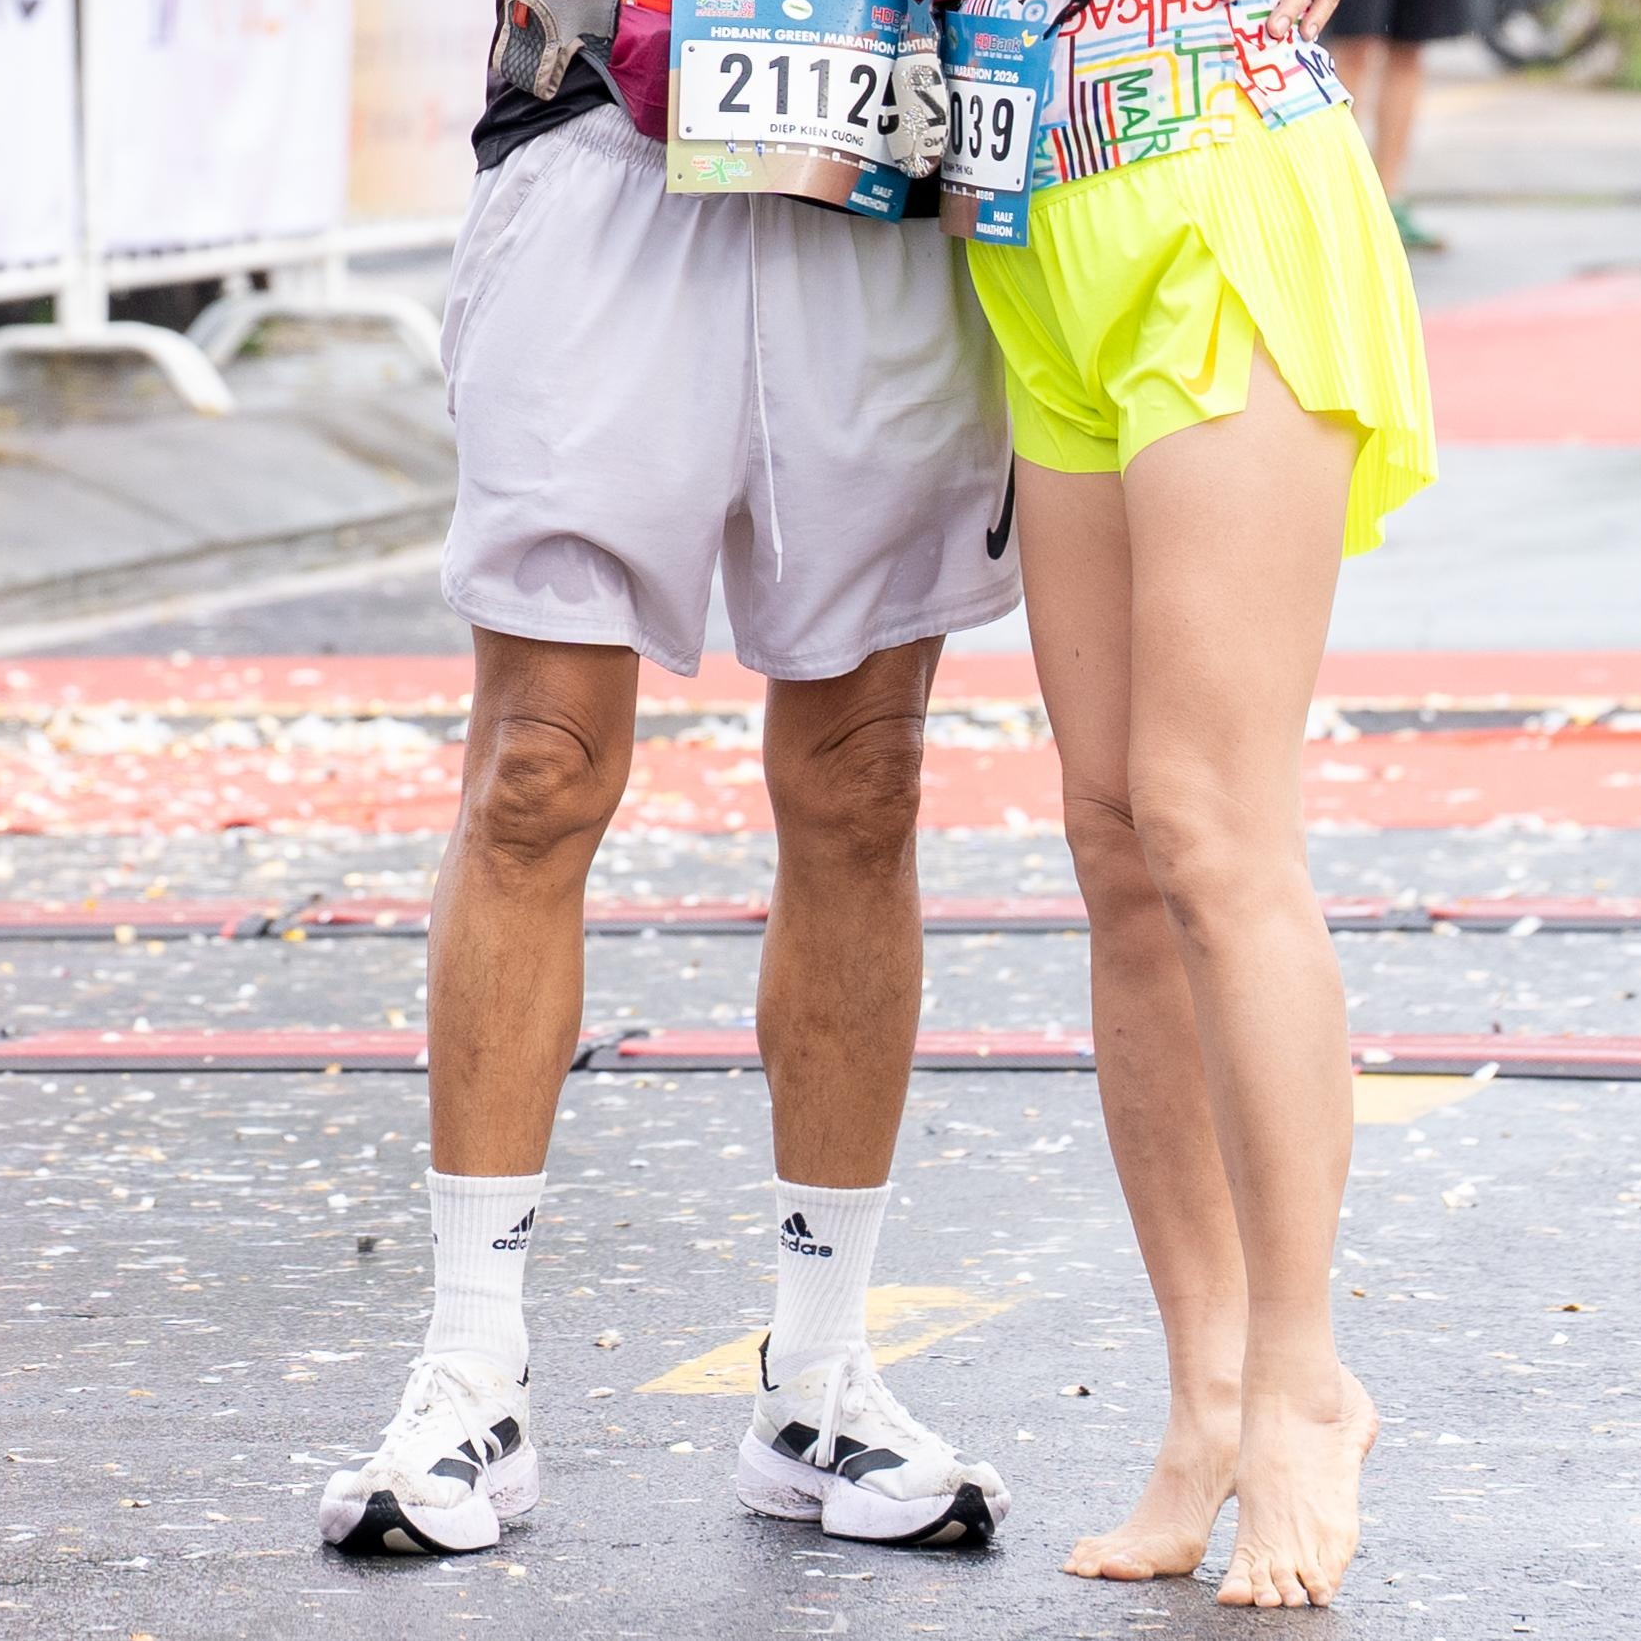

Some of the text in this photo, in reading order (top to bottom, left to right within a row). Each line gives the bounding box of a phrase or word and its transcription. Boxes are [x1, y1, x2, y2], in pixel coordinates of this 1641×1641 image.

[710, 26, 896, 56] HDBANK GREEN MARATHON
[974, 32, 1022, 53] HDBank
[993, 69, 1019, 84] 2026
[950, 90, 1015, 162] 039
[993, 210, 1014, 224] HALF
